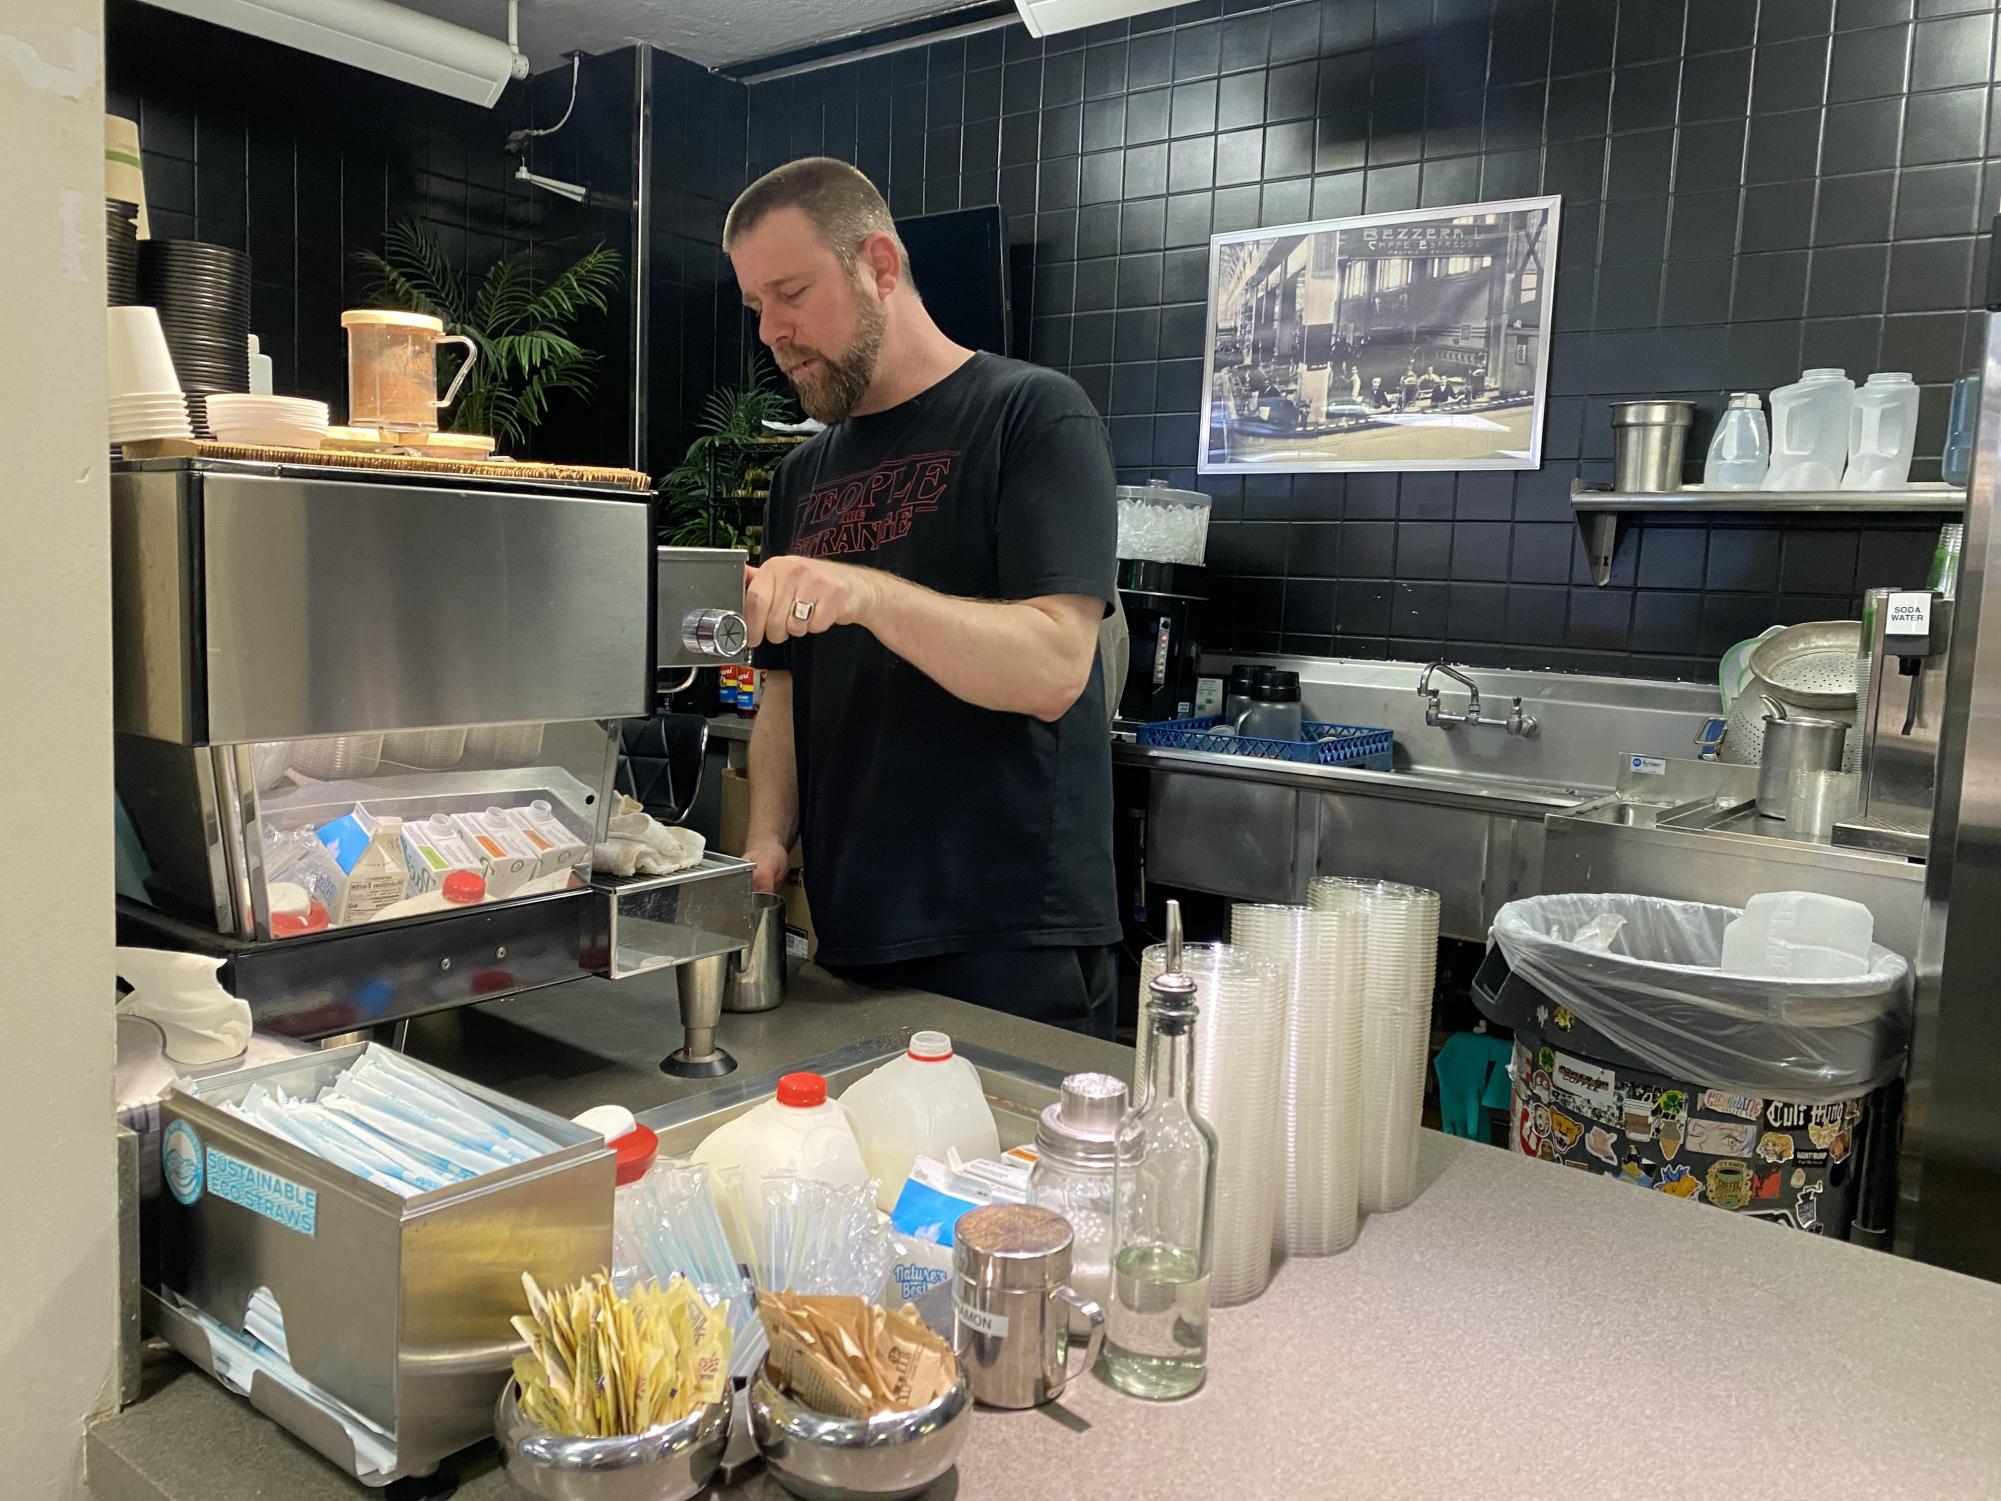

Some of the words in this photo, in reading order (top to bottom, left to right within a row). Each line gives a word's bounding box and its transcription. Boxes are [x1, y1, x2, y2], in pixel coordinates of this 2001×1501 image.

[1363, 228, 1464, 241] BEZZERA
[1891, 614, 1924, 622] WATER
[1894, 606, 1921, 614] SODA
[207, 1152, 315, 1209] SUSTAINABLE
[210, 1176, 241, 1201] ECO
[244, 1192, 313, 1232] STRAWS
[901, 1280, 929, 1299] Best
[959, 1305, 993, 1330] AMON
